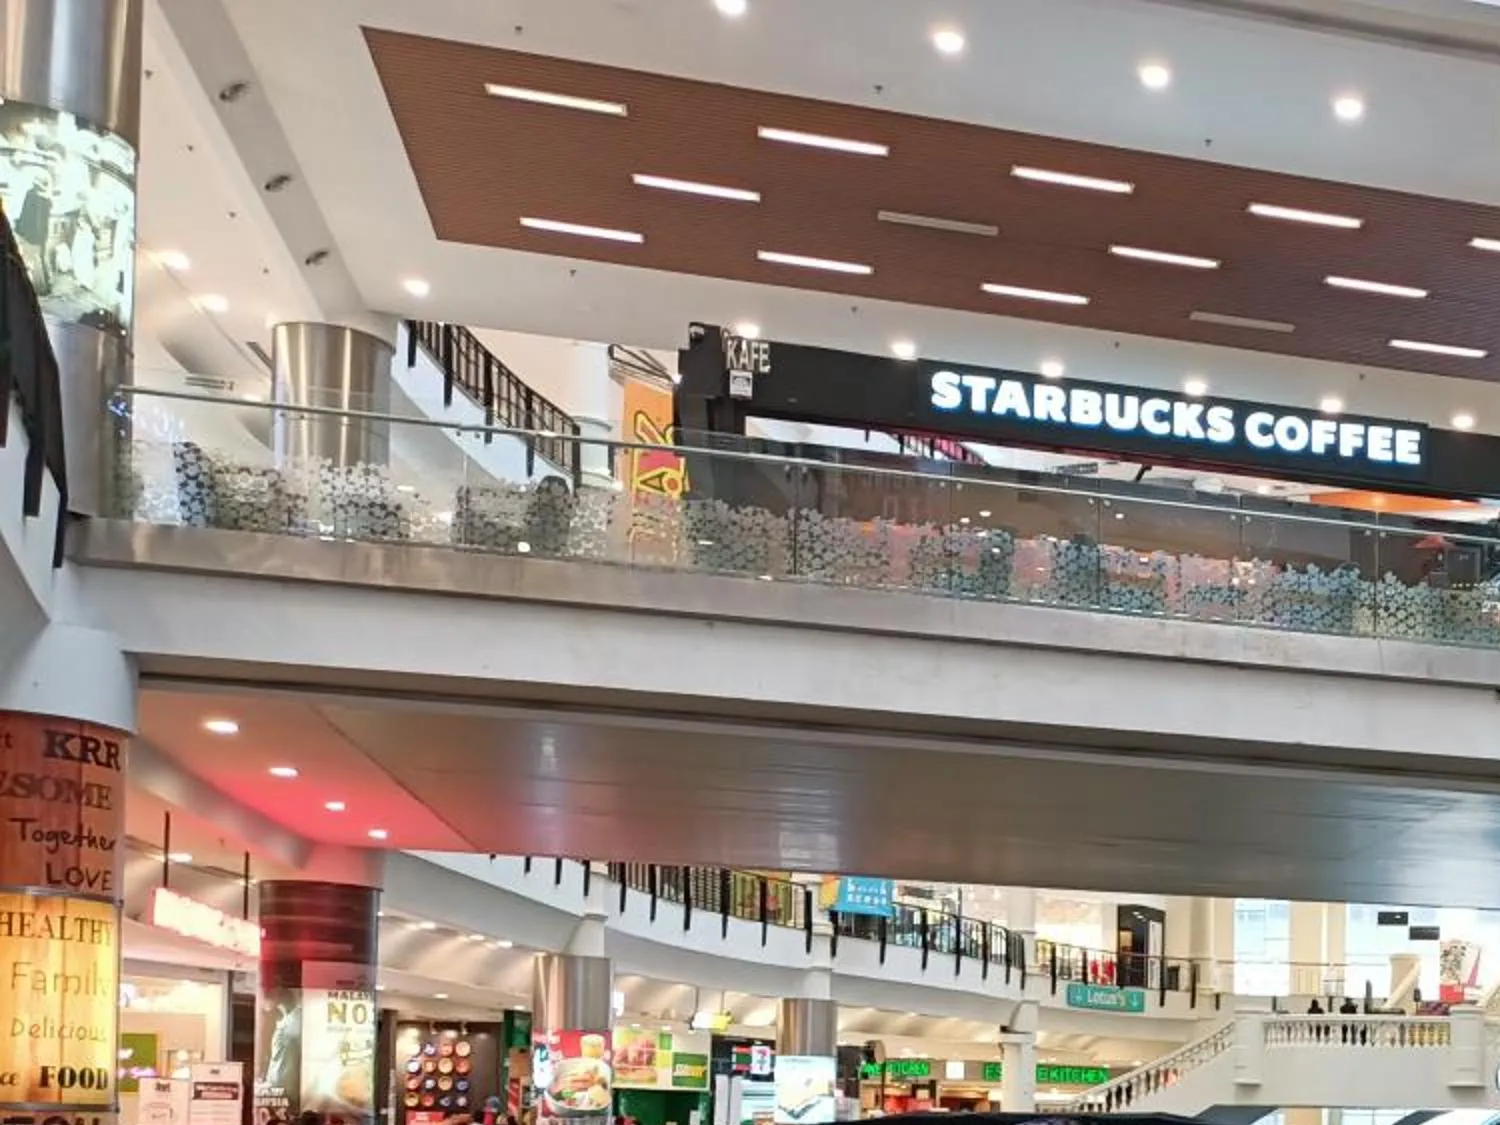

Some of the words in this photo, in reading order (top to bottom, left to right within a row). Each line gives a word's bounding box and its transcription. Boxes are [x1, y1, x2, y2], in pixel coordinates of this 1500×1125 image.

[726, 338, 771, 373] KAFE
[930, 370, 1235, 443] STARBUCKS
[1244, 411, 1422, 465] COFFEE
[8, 817, 117, 855] Together
[45, 862, 113, 892] LOVE
[38, 1064, 109, 1090] FOOD
